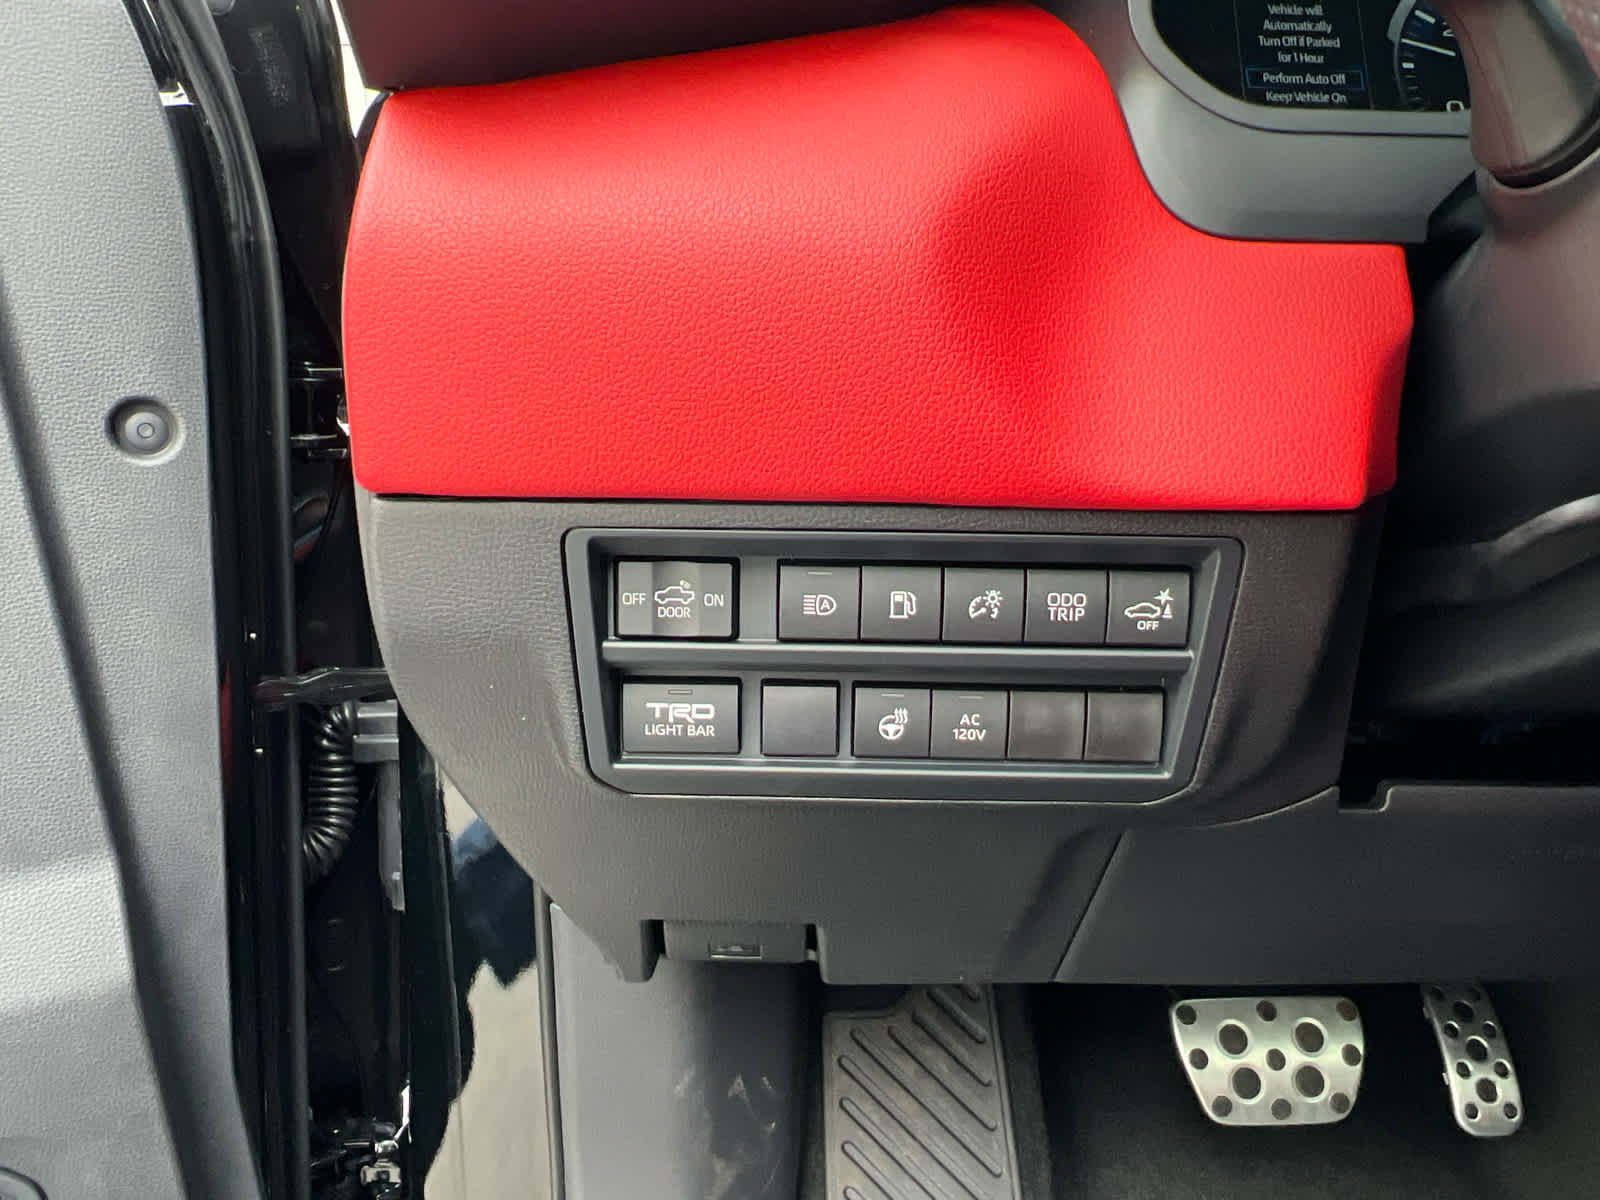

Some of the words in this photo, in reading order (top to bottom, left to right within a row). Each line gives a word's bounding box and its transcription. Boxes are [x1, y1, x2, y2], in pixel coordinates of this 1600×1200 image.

[1267, 3, 1304, 16] Vehicle
[1305, 4, 1323, 16] will
[1263, 19, 1332, 34] Automatically
[1257, 35, 1281, 47] Turn
[1282, 36, 1297, 47] Off
[1298, 36, 1305, 47] if
[1306, 36, 1341, 48] Parked
[1277, 51, 1291, 63] for
[1293, 52, 1298, 63] 1
[1299, 52, 1325, 64] Hour
[1262, 72, 1303, 84] Perform
[1305, 73, 1329, 85] Auto
[1330, 73, 1346, 85] Off
[1265, 91, 1293, 103] Keep
[1294, 91, 1330, 103] Vehicle
[1331, 92, 1347, 103] On
[622, 592, 646, 606] OFF
[703, 593, 724, 607] ON
[1047, 592, 1087, 607] ODO
[657, 606, 690, 618] DOOR
[1047, 607, 1085, 622] TRIP
[1136, 620, 1159, 631] OFF
[645, 702, 715, 723] TRD
[959, 713, 981, 726] AC
[644, 724, 683, 737] LIGHT
[687, 725, 715, 738] BAR
[952, 728, 987, 741] 120V
